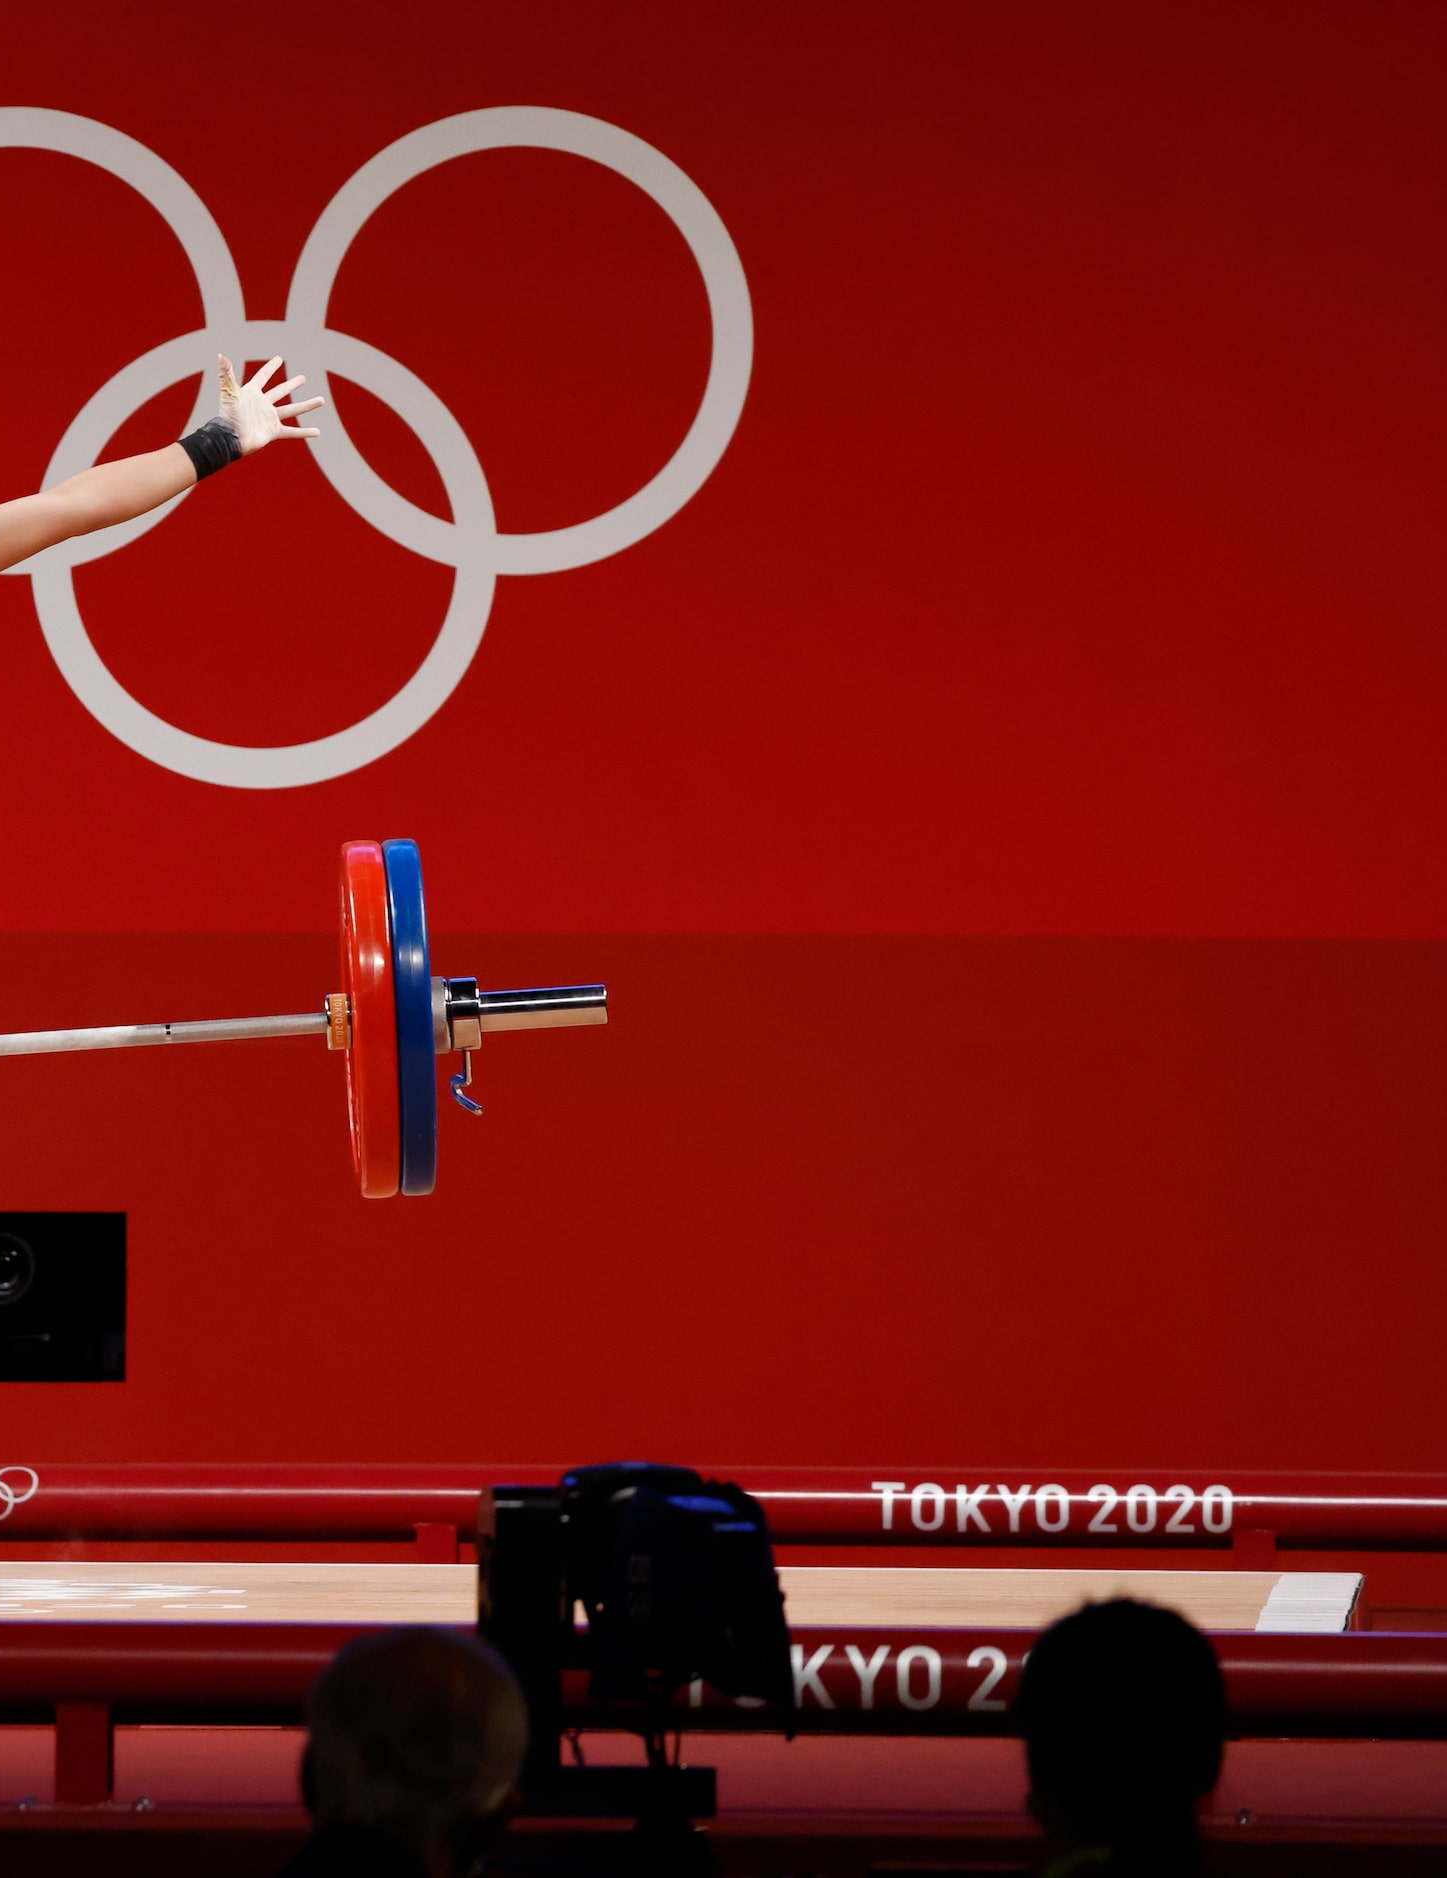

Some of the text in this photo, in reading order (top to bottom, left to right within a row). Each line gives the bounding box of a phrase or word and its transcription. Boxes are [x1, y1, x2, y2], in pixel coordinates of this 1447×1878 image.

[333, 999, 344, 1024] TOKYO
[871, 1481, 1234, 1533] TOKYO 2020
